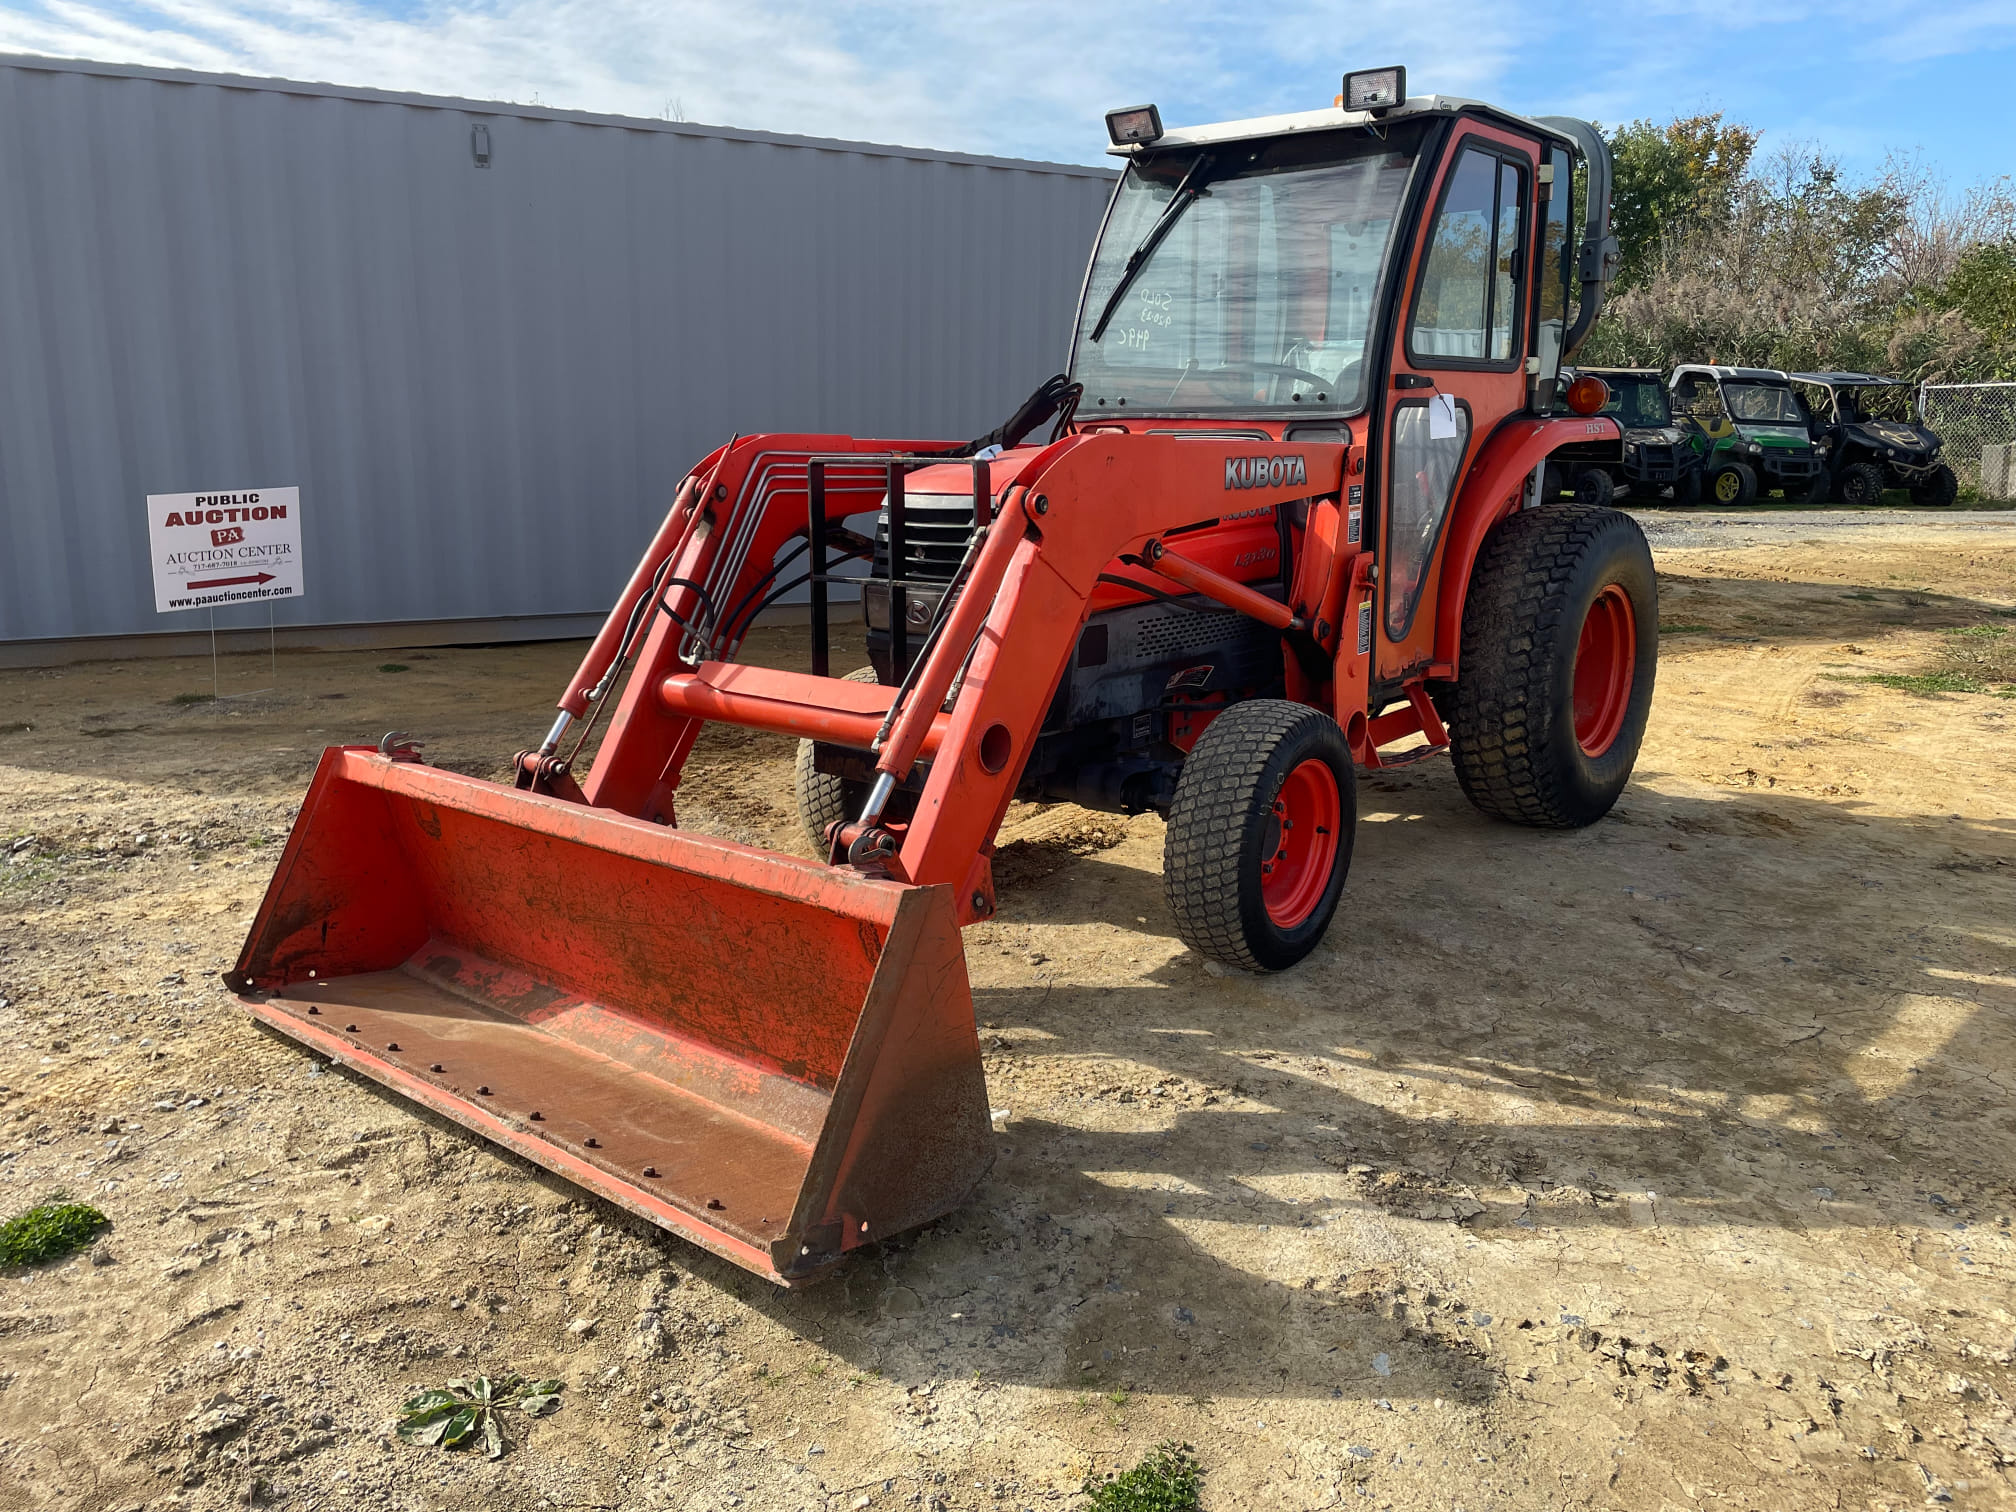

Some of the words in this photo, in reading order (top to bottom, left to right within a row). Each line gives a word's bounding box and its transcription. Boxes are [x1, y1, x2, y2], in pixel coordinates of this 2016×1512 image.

[1585, 423, 1606, 434] HST
[1225, 455, 1307, 490] KUBOTA
[195, 493, 260, 507] PUBLIC
[165, 505, 287, 527] AUCTION
[217, 529, 240, 543] PA
[166, 548, 234, 565] AUCTION
[238, 543, 292, 558] CENTER
[169, 586, 292, 608] www.paauctioncenter.com
